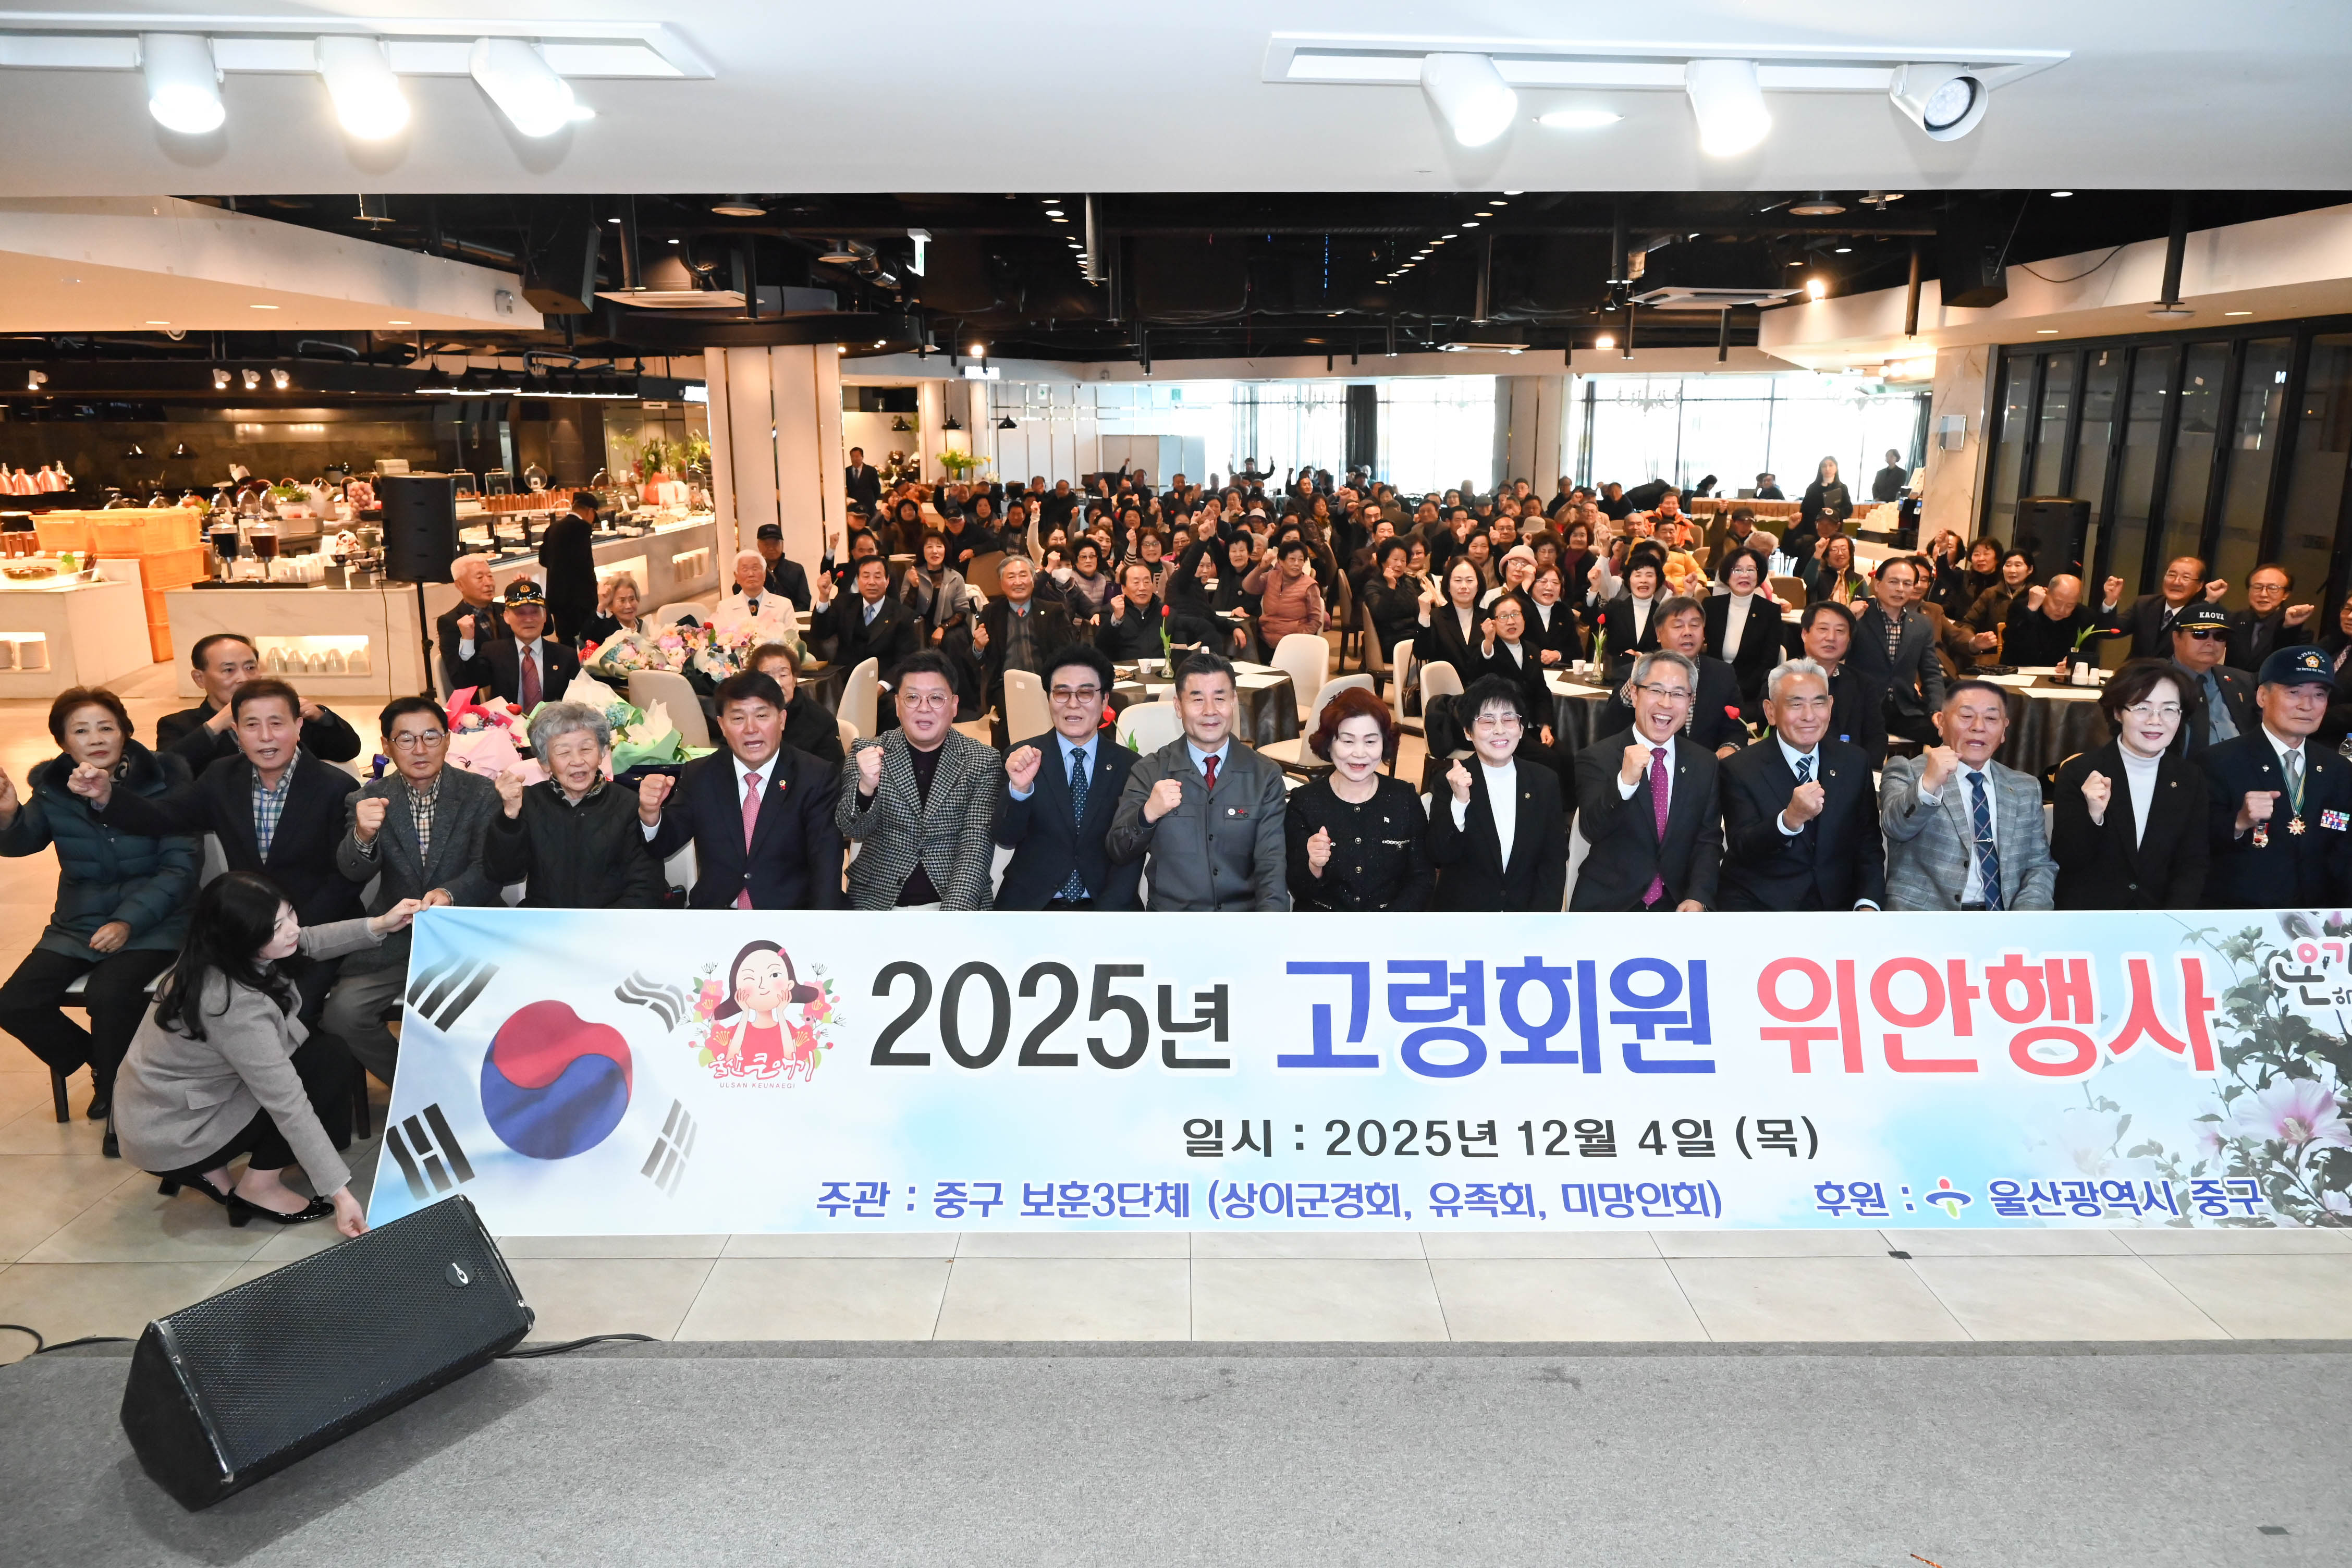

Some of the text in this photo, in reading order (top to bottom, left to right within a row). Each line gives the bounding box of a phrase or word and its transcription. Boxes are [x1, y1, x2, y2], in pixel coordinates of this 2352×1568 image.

[2199, 612, 2224, 620] KAOVA
[871, 954, 2214, 1077] 2025년 고령회원 위안행사
[1183, 1119, 1271, 1157] 일시
[1326, 1120, 1498, 1157] 2025년
[1518, 1119, 1616, 1157] 12월
[1639, 1119, 1715, 1157] 4일
[1736, 1116, 1817, 1159] (목)
[817, 1182, 890, 1217] 주관
[934, 1183, 1003, 1218] 중구
[1021, 1181, 1189, 1217] 보훈3단체
[1209, 1180, 1411, 1220] (상이군경회,
[1430, 1183, 1546, 1219] 유족회,
[1562, 1180, 1721, 1218] 미망인회)
[1815, 1181, 1889, 1216] 후원
[1990, 1181, 2178, 1217] 울산광역시
[2191, 1180, 2263, 1216] 중구
